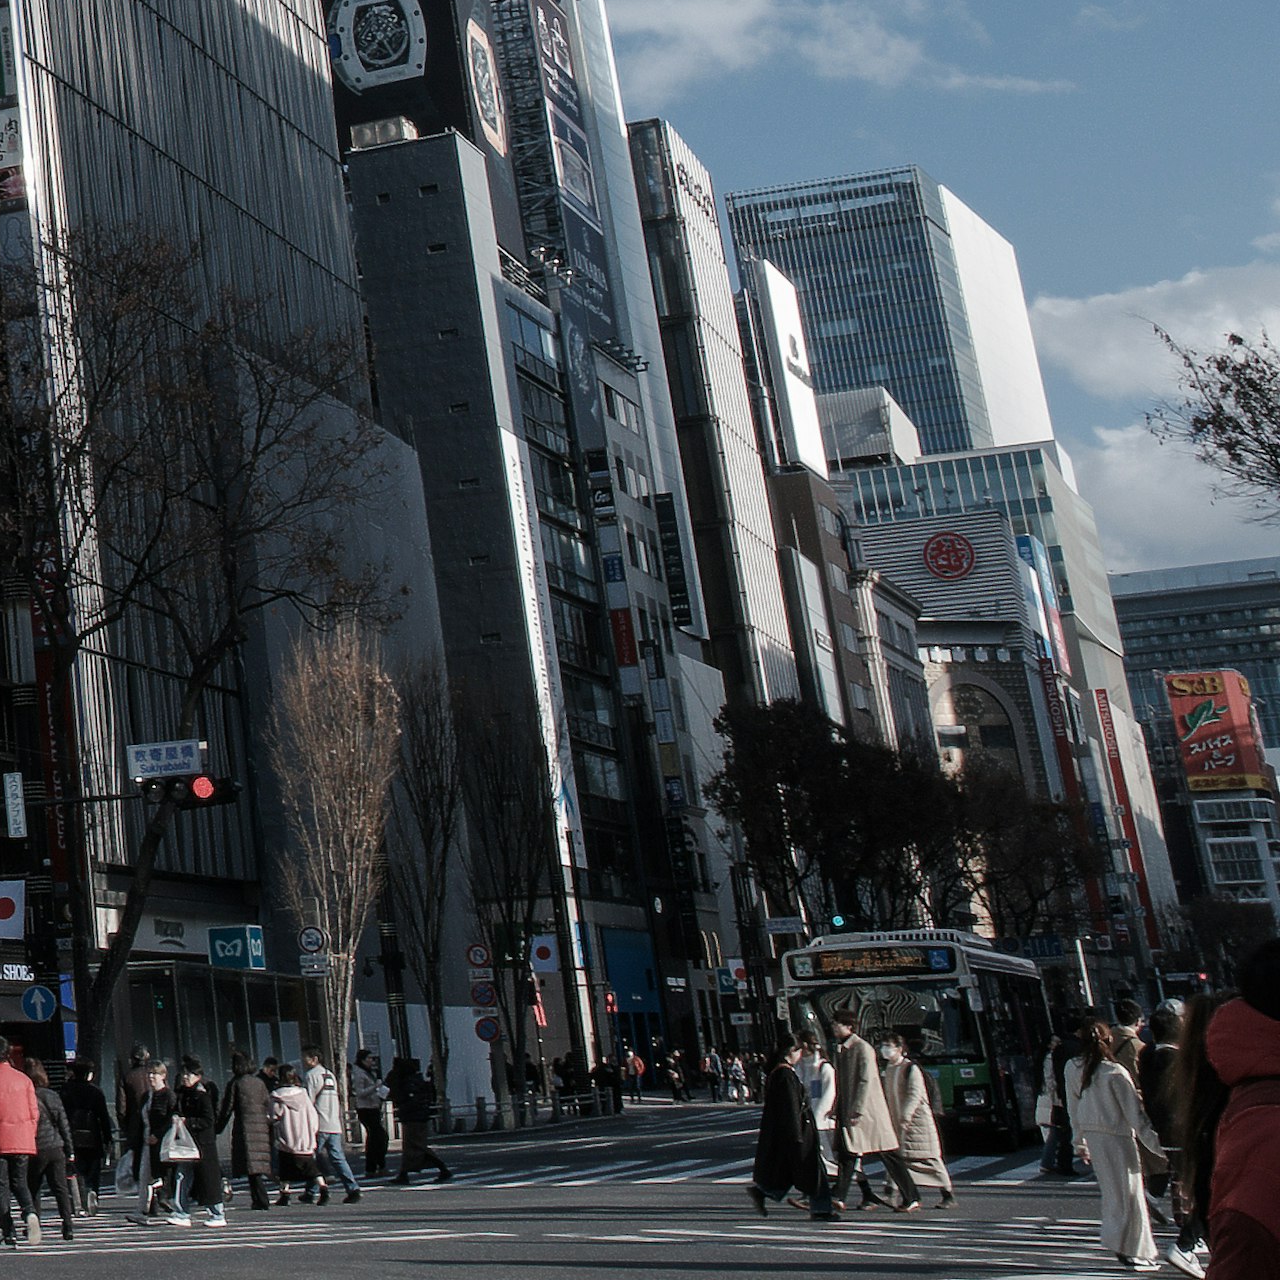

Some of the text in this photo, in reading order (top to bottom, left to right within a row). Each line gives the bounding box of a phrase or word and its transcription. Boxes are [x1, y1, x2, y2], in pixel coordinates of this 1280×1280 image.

[1171, 675, 1224, 696] S&B
[1042, 661, 1065, 738] MITSUKOSHI
[1096, 693, 1119, 759] MITSUKOSHI
[134, 743, 194, 763] 数寄屋橋
[1189, 734, 1234, 756] スパイス
[1203, 753, 1236, 771] ハーブ
